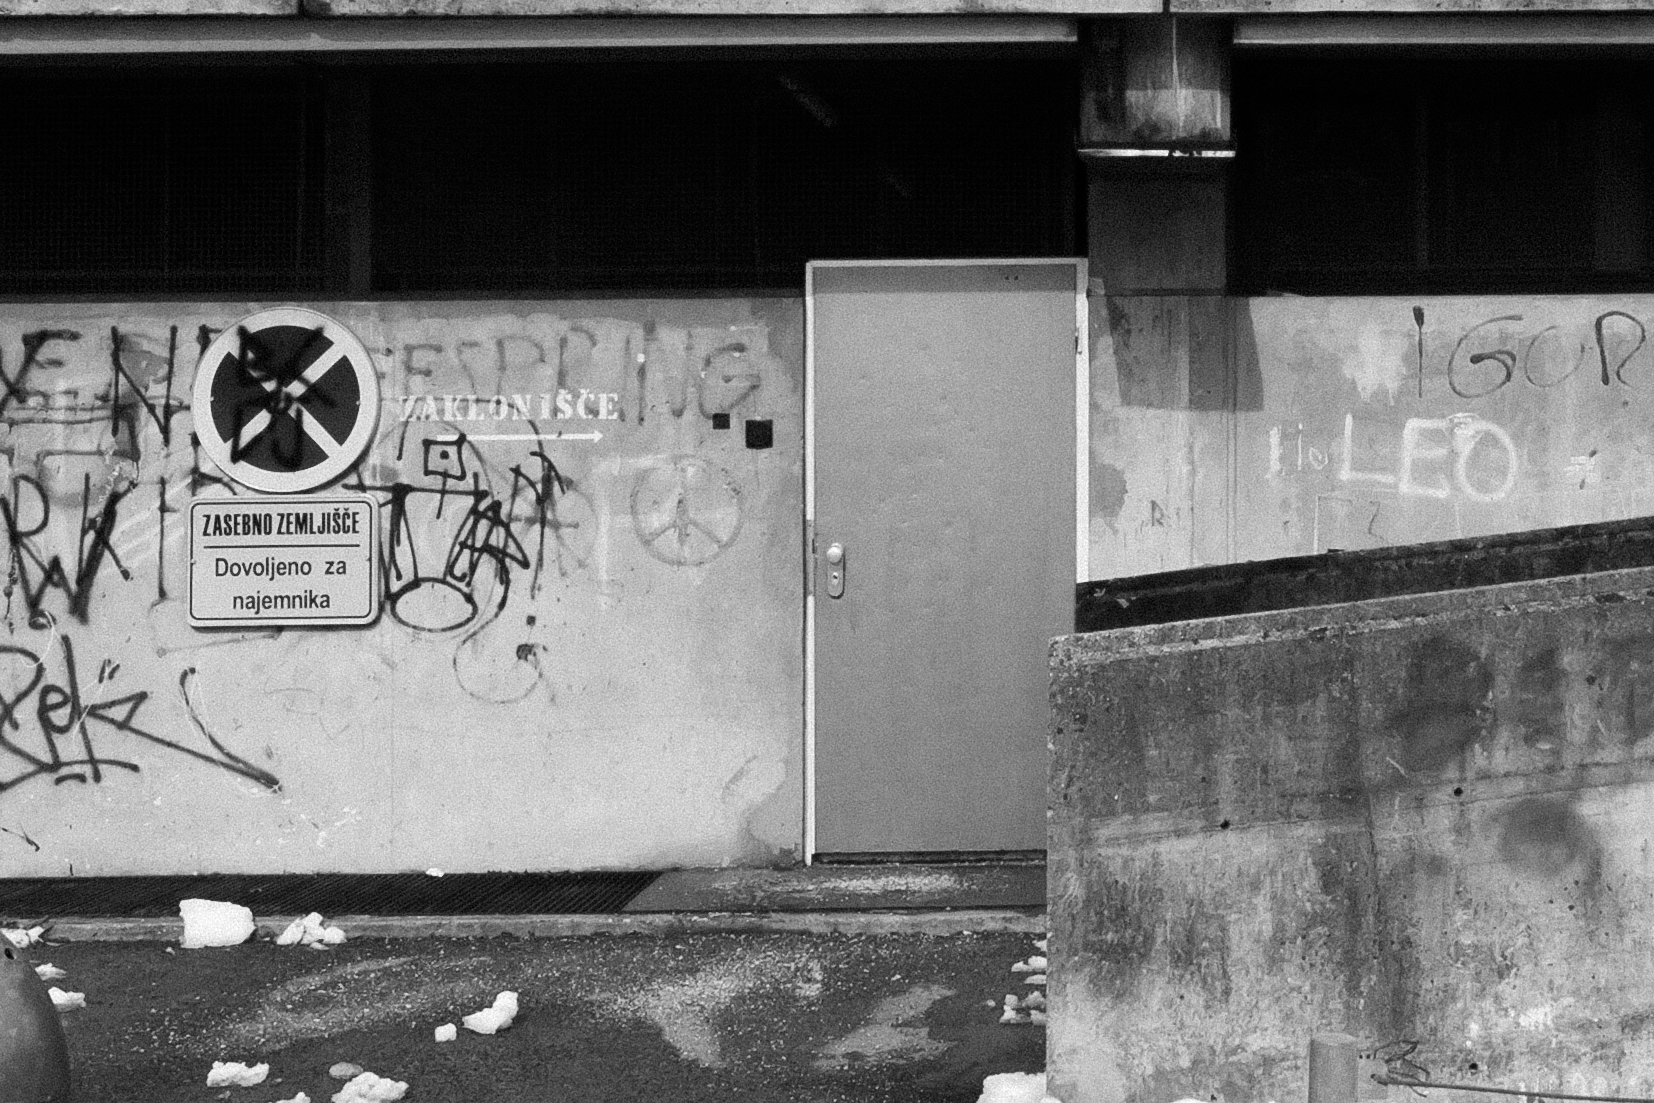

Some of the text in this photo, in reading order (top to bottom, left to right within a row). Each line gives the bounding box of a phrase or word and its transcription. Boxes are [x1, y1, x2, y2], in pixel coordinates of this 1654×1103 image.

[1411, 304, 1647, 399] IGOR
[399, 387, 620, 422] ZAKLONIŠČE
[1337, 410, 1519, 499] LEO
[202, 508, 360, 537] ZASEBNO ZEMLJIŠČE
[214, 557, 348, 582] Dovoljeno za
[232, 590, 331, 616] najemnika
